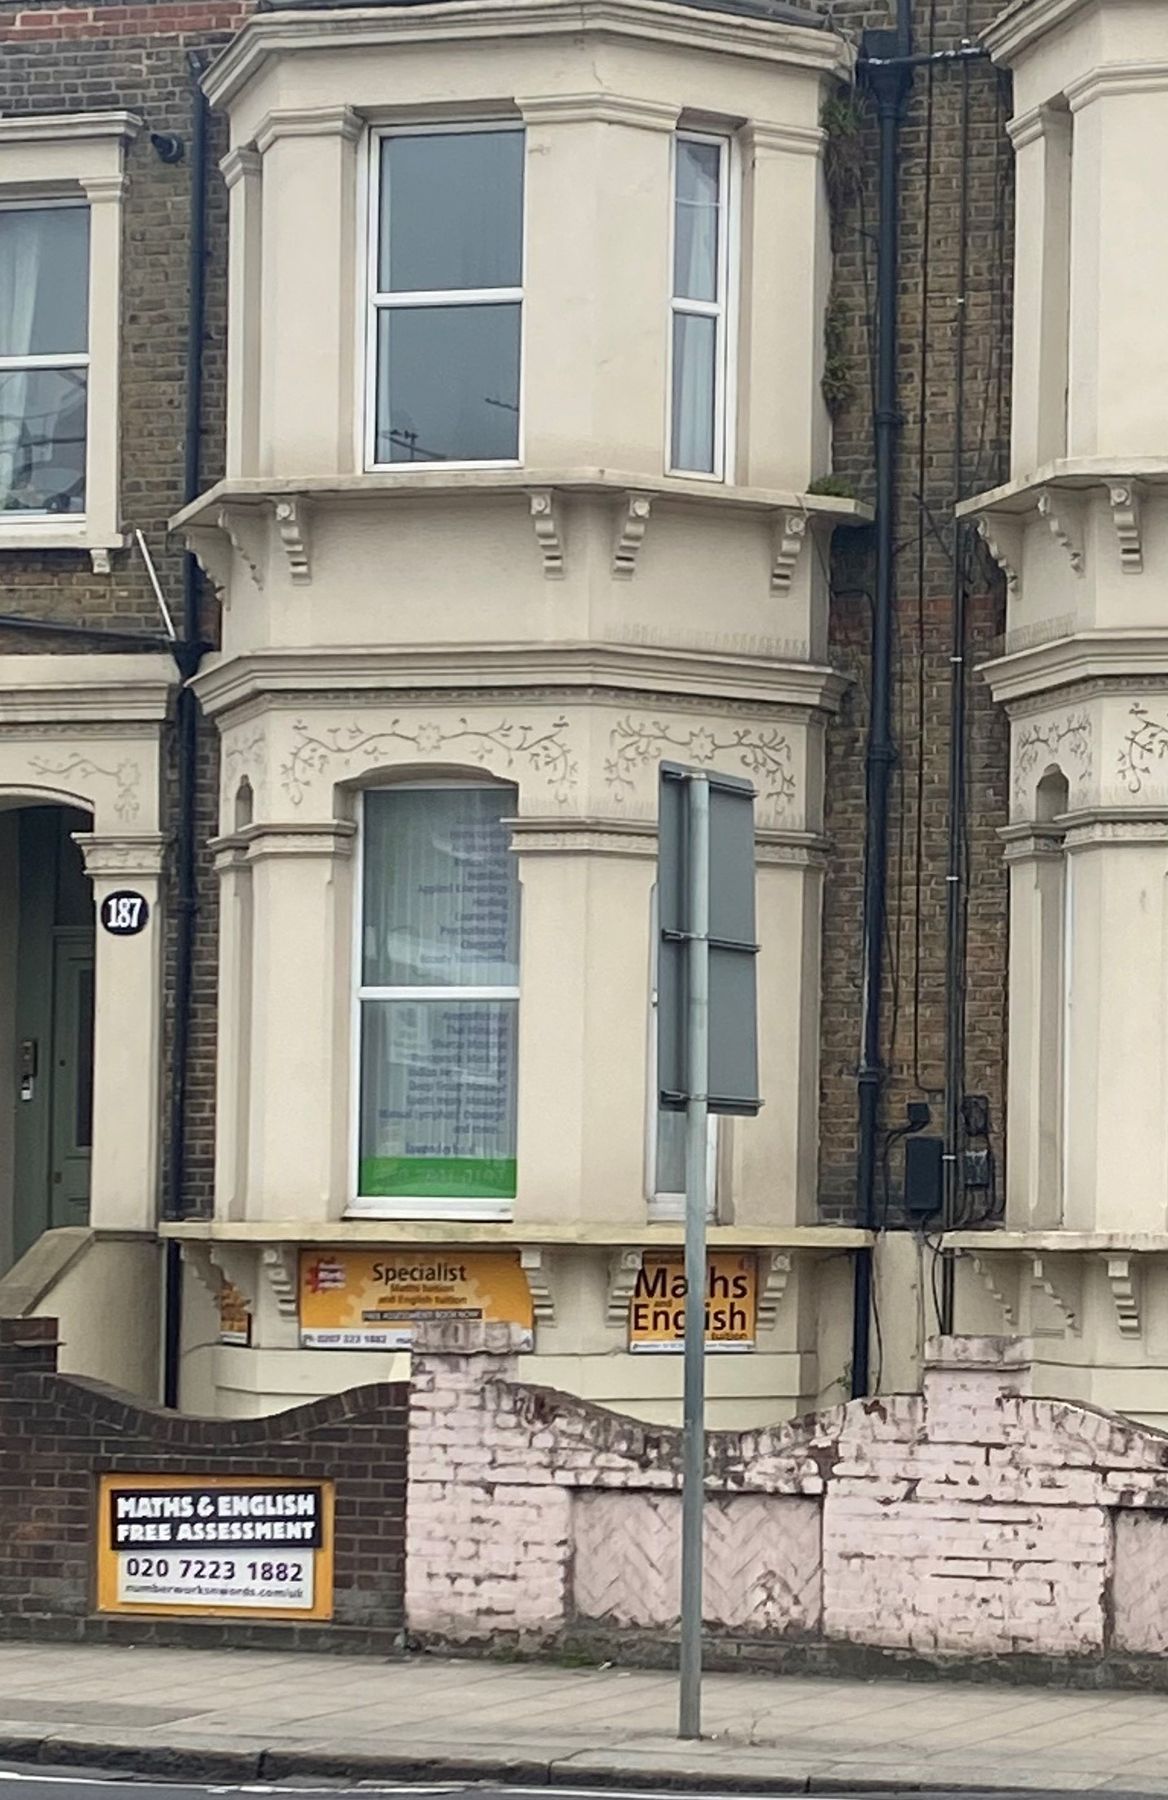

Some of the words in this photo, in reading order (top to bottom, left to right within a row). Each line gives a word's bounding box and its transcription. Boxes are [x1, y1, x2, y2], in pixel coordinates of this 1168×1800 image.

[106, 897, 142, 928] 187
[372, 1262, 467, 1286] Specialist
[635, 1267, 748, 1299] Mahs
[634, 1302, 747, 1338] Engish
[117, 1496, 194, 1518] MATHS
[197, 1494, 215, 1517] &
[218, 1494, 315, 1517] ENGLISH
[117, 1523, 171, 1542] FREE
[177, 1521, 316, 1541] ASSESSMENT
[127, 1558, 169, 1578] 020
[178, 1559, 236, 1580] 7223
[247, 1562, 304, 1582] 1882
